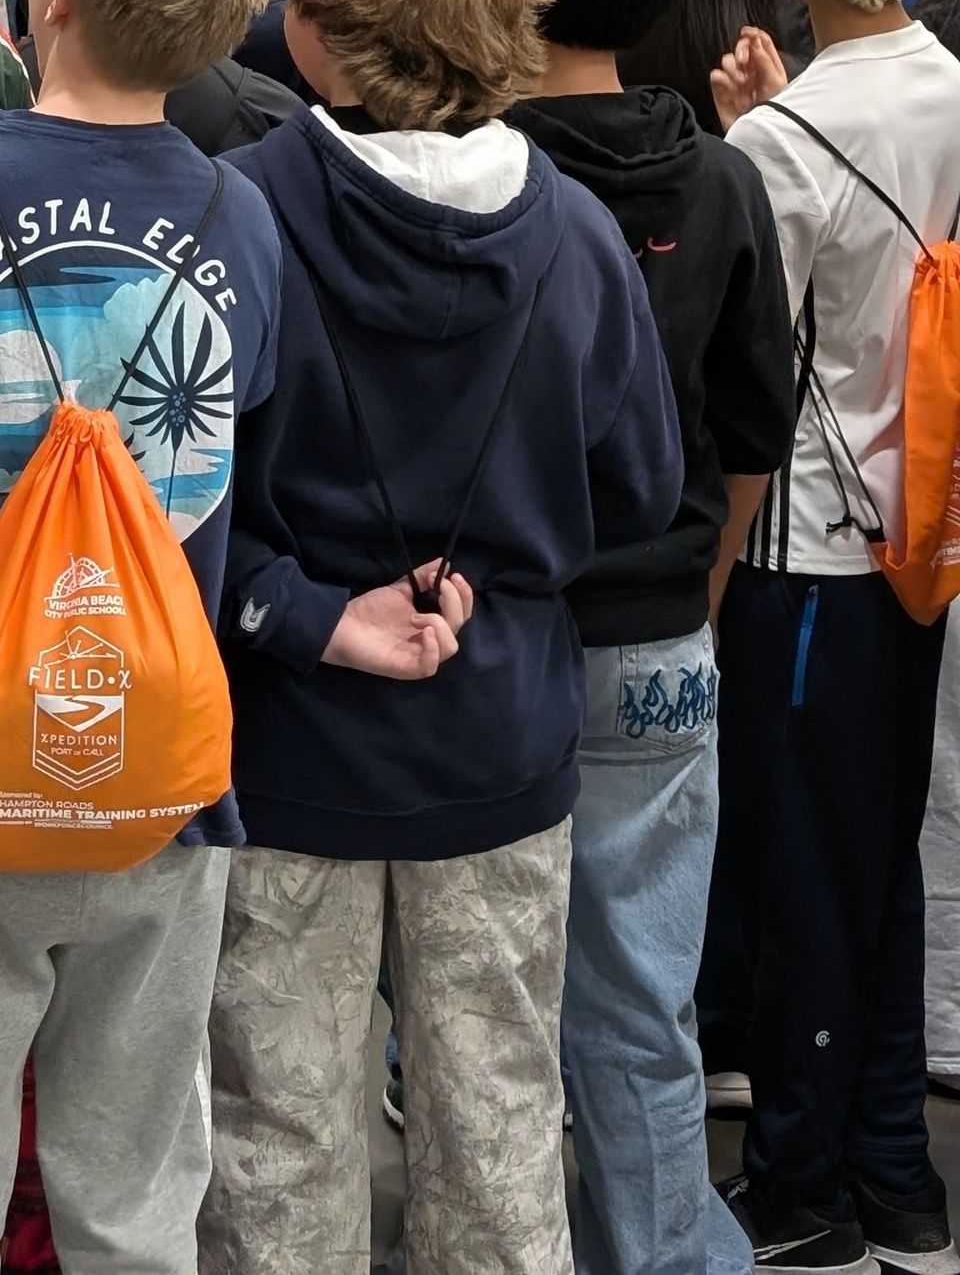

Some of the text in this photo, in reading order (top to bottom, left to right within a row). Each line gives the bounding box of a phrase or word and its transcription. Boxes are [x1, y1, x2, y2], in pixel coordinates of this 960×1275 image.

[142, 217, 237, 313] EDGE
[41, 733, 117, 745] XPEDITION
[0, 799, 94, 811] HAMPTON ROADS
[76, 809, 146, 821] TRAINING
